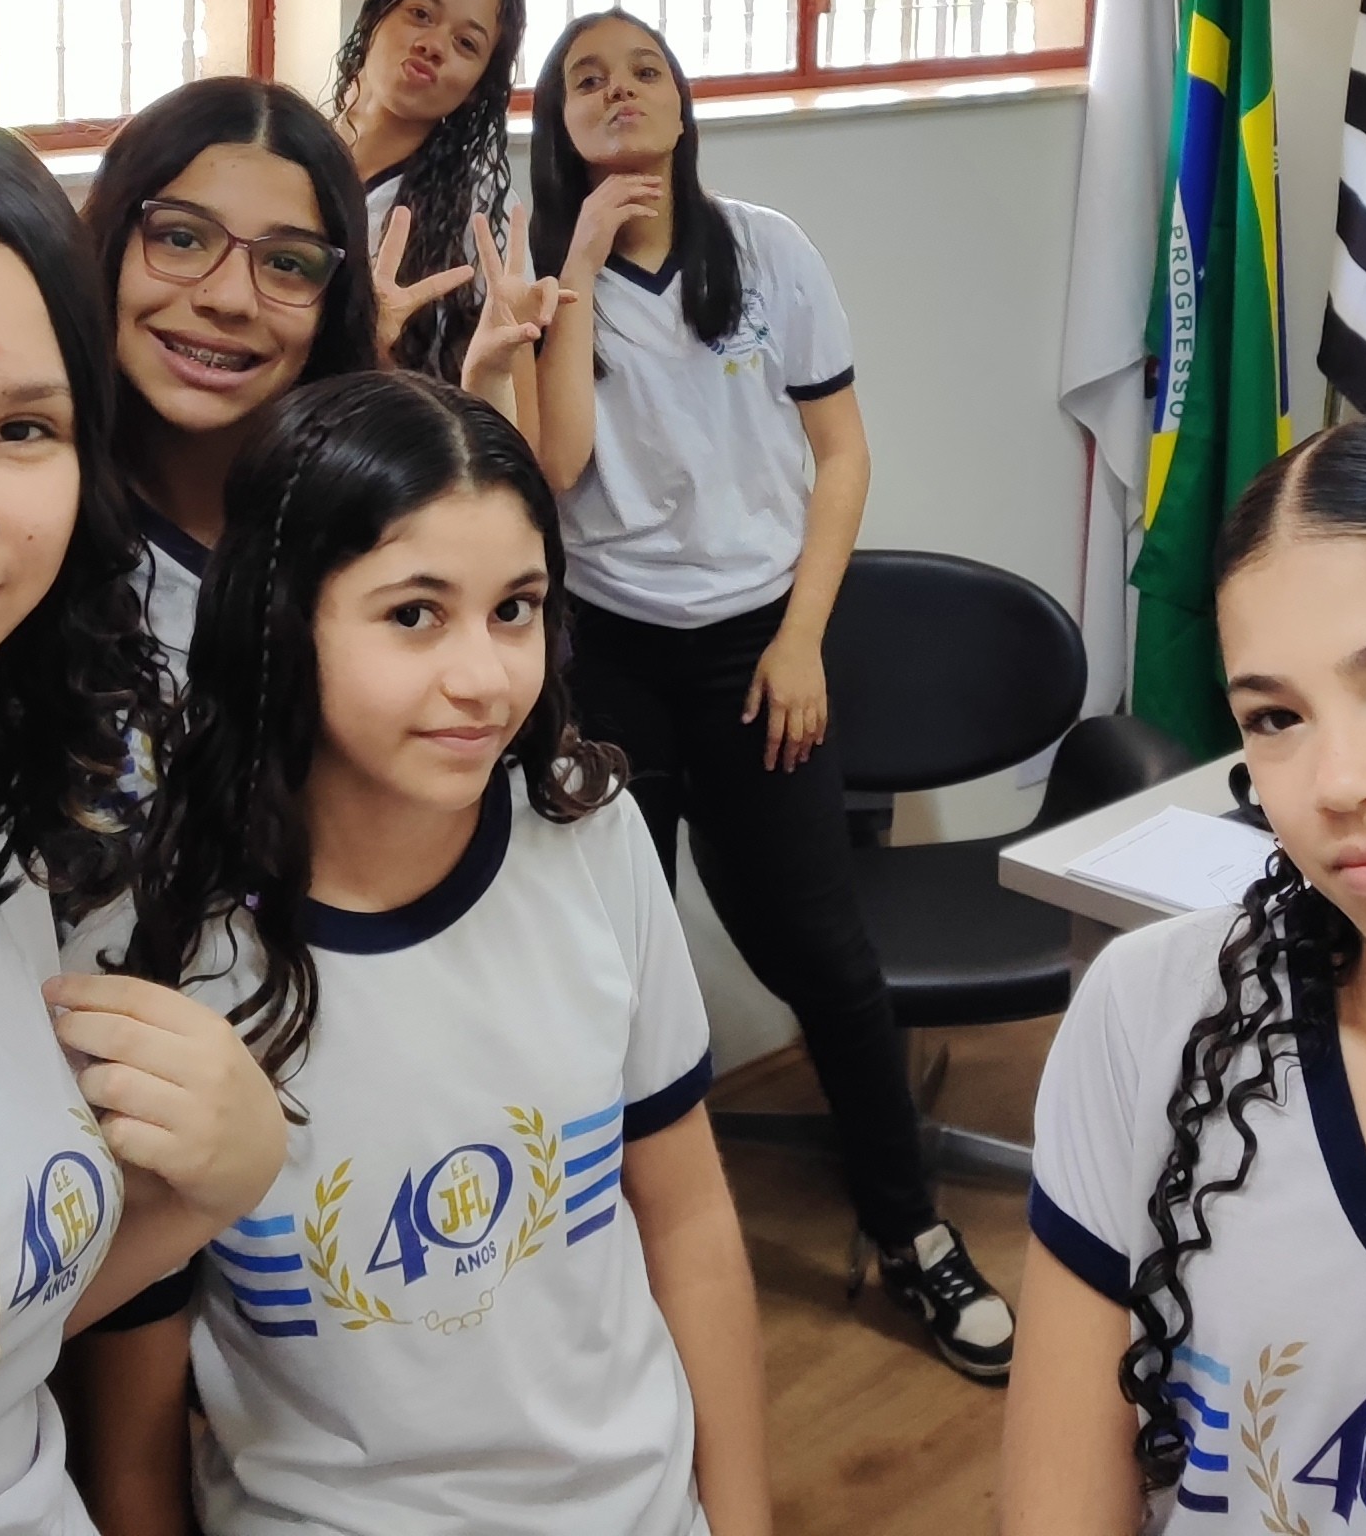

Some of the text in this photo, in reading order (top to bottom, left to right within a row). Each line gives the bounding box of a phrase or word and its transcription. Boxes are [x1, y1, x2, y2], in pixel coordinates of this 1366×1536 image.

[1168, 224, 1194, 420] PROGRESSO
[8, 1150, 105, 1314] 40
[50, 1186, 95, 1259] JFL
[364, 1143, 514, 1287] 40
[438, 1175, 492, 1235] JFL
[42, 1264, 80, 1305] ANOS
[454, 1240, 498, 1277] ANOS
